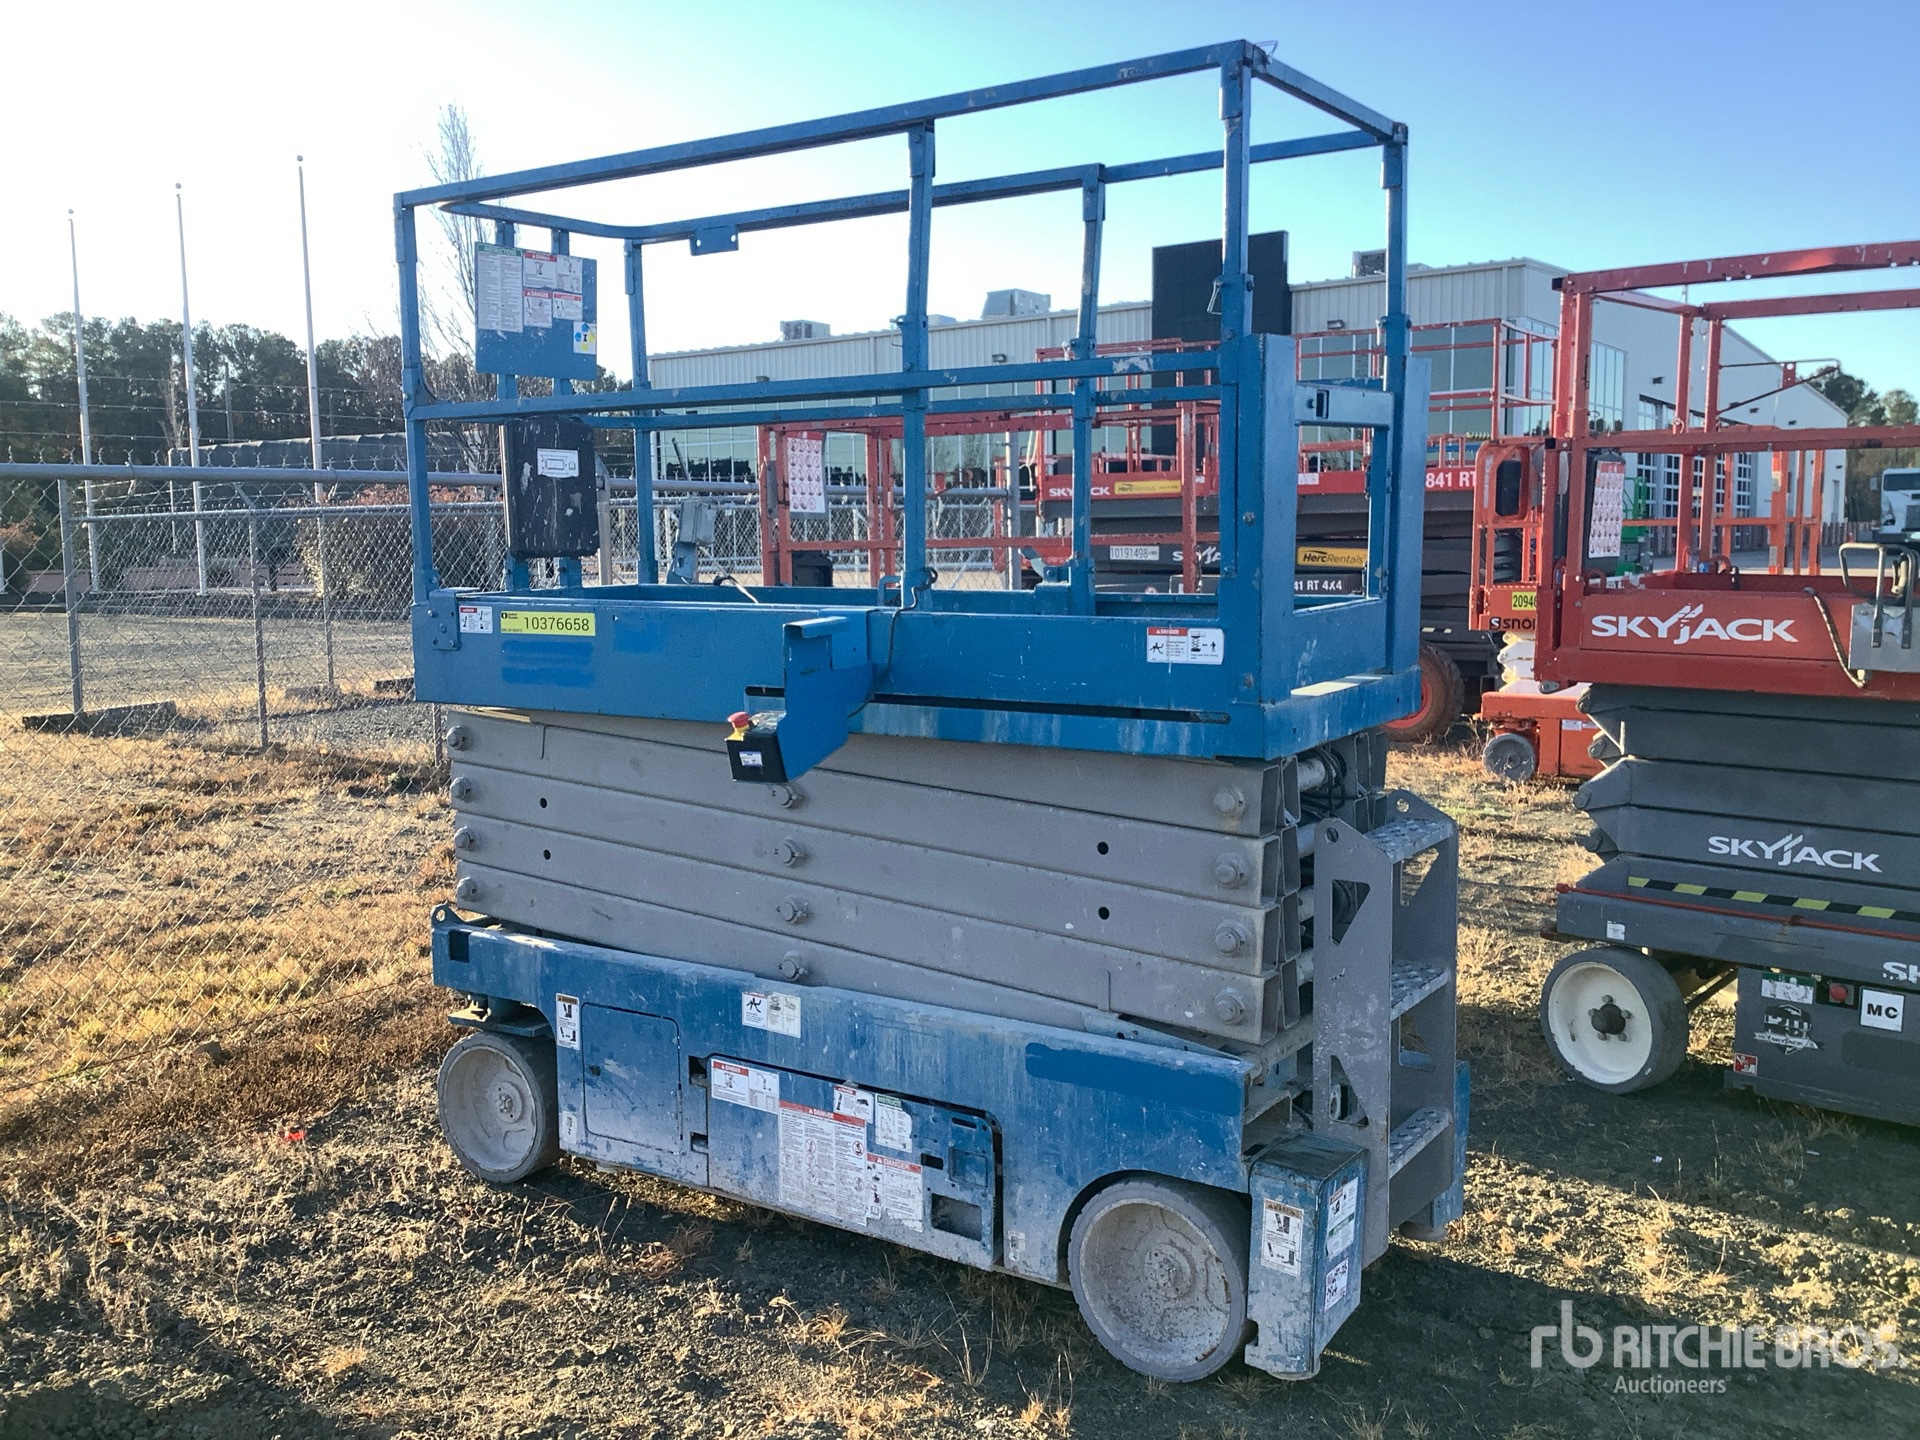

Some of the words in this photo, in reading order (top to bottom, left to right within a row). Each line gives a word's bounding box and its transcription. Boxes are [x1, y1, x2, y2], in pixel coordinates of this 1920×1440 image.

[1049, 487, 1110, 497] SKYCK
[1110, 546, 1149, 559] 10191498
[1303, 551, 1364, 565] HercRentals
[1307, 581, 1319, 591] RT
[524, 617, 589, 631] 10376658
[1592, 603, 1799, 645] SKYJACK
[1708, 834, 1882, 873] SKYJACK
[1867, 1003, 1900, 1019] MC
[725, 1065, 741, 1074] DANGER
[813, 1108, 834, 1119] DANGER
[883, 1158, 910, 1170] DANGER
